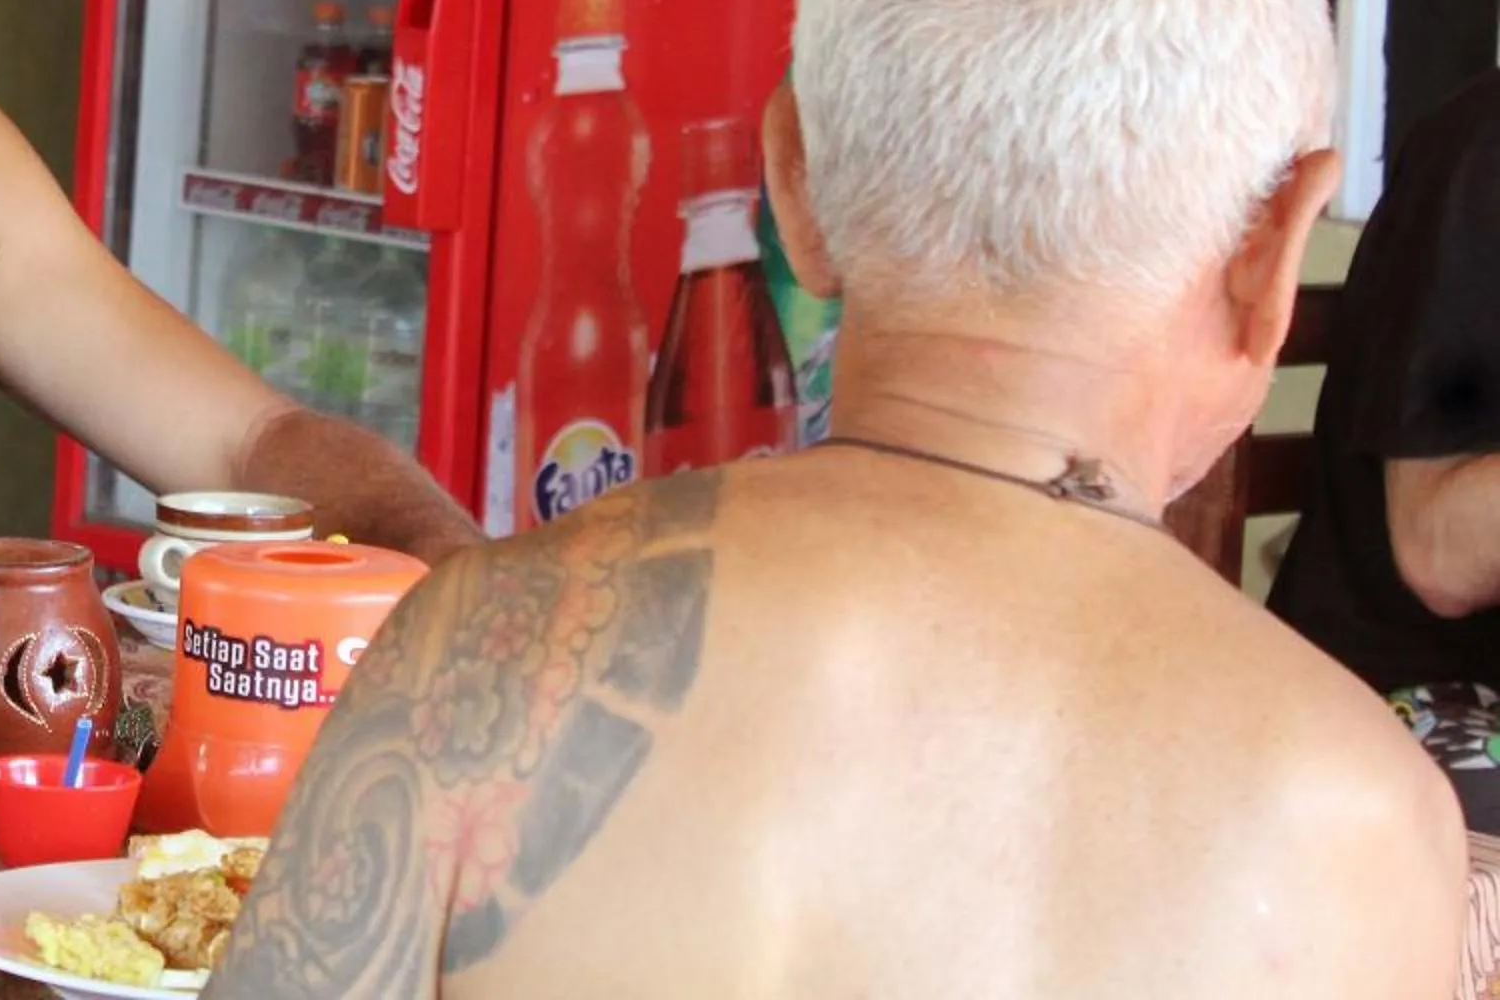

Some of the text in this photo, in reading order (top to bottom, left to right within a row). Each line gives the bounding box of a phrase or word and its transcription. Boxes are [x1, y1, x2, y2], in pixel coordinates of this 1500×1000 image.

[535, 445, 634, 522] Fanta
[184, 623, 245, 668] Setiap
[254, 639, 319, 673] Saat
